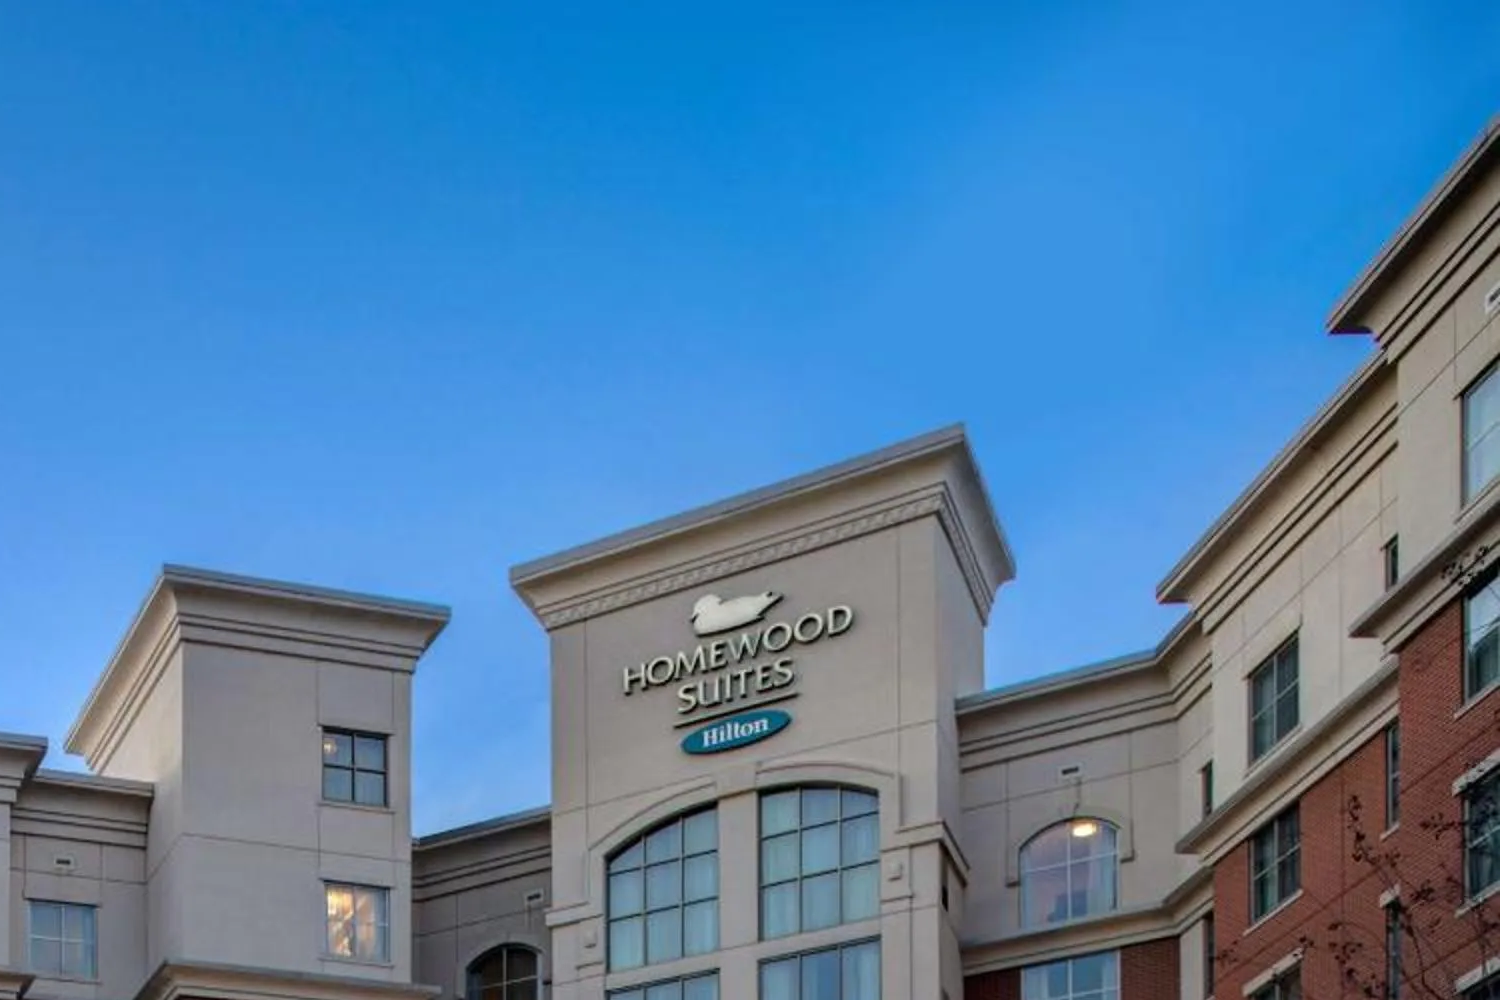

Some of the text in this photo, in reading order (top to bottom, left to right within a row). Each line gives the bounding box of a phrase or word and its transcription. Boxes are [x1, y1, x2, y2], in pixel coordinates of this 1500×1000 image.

[623, 605, 853, 695] HOMEWOOD
[677, 658, 795, 714] SUITES
[702, 717, 769, 748] Hilton
